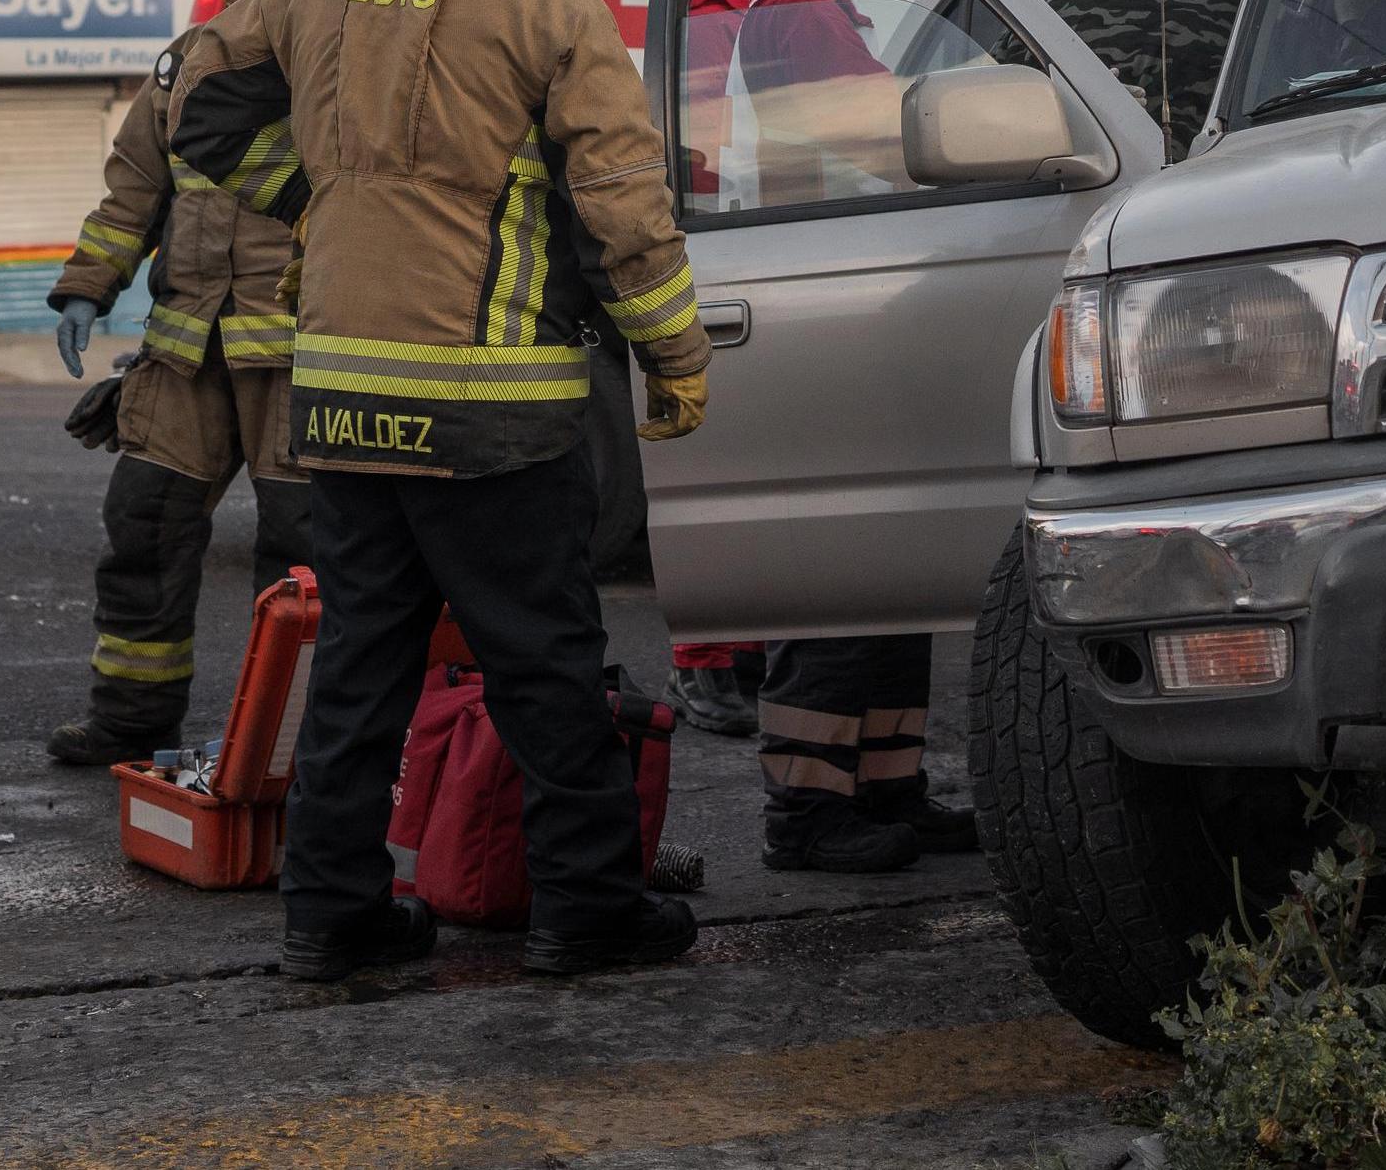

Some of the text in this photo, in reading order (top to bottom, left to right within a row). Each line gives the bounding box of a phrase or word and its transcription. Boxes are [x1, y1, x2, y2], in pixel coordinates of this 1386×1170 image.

[26, 49, 48, 66] La
[54, 48, 103, 70] Mejor
[306, 407, 432, 453] A VALDEZ
